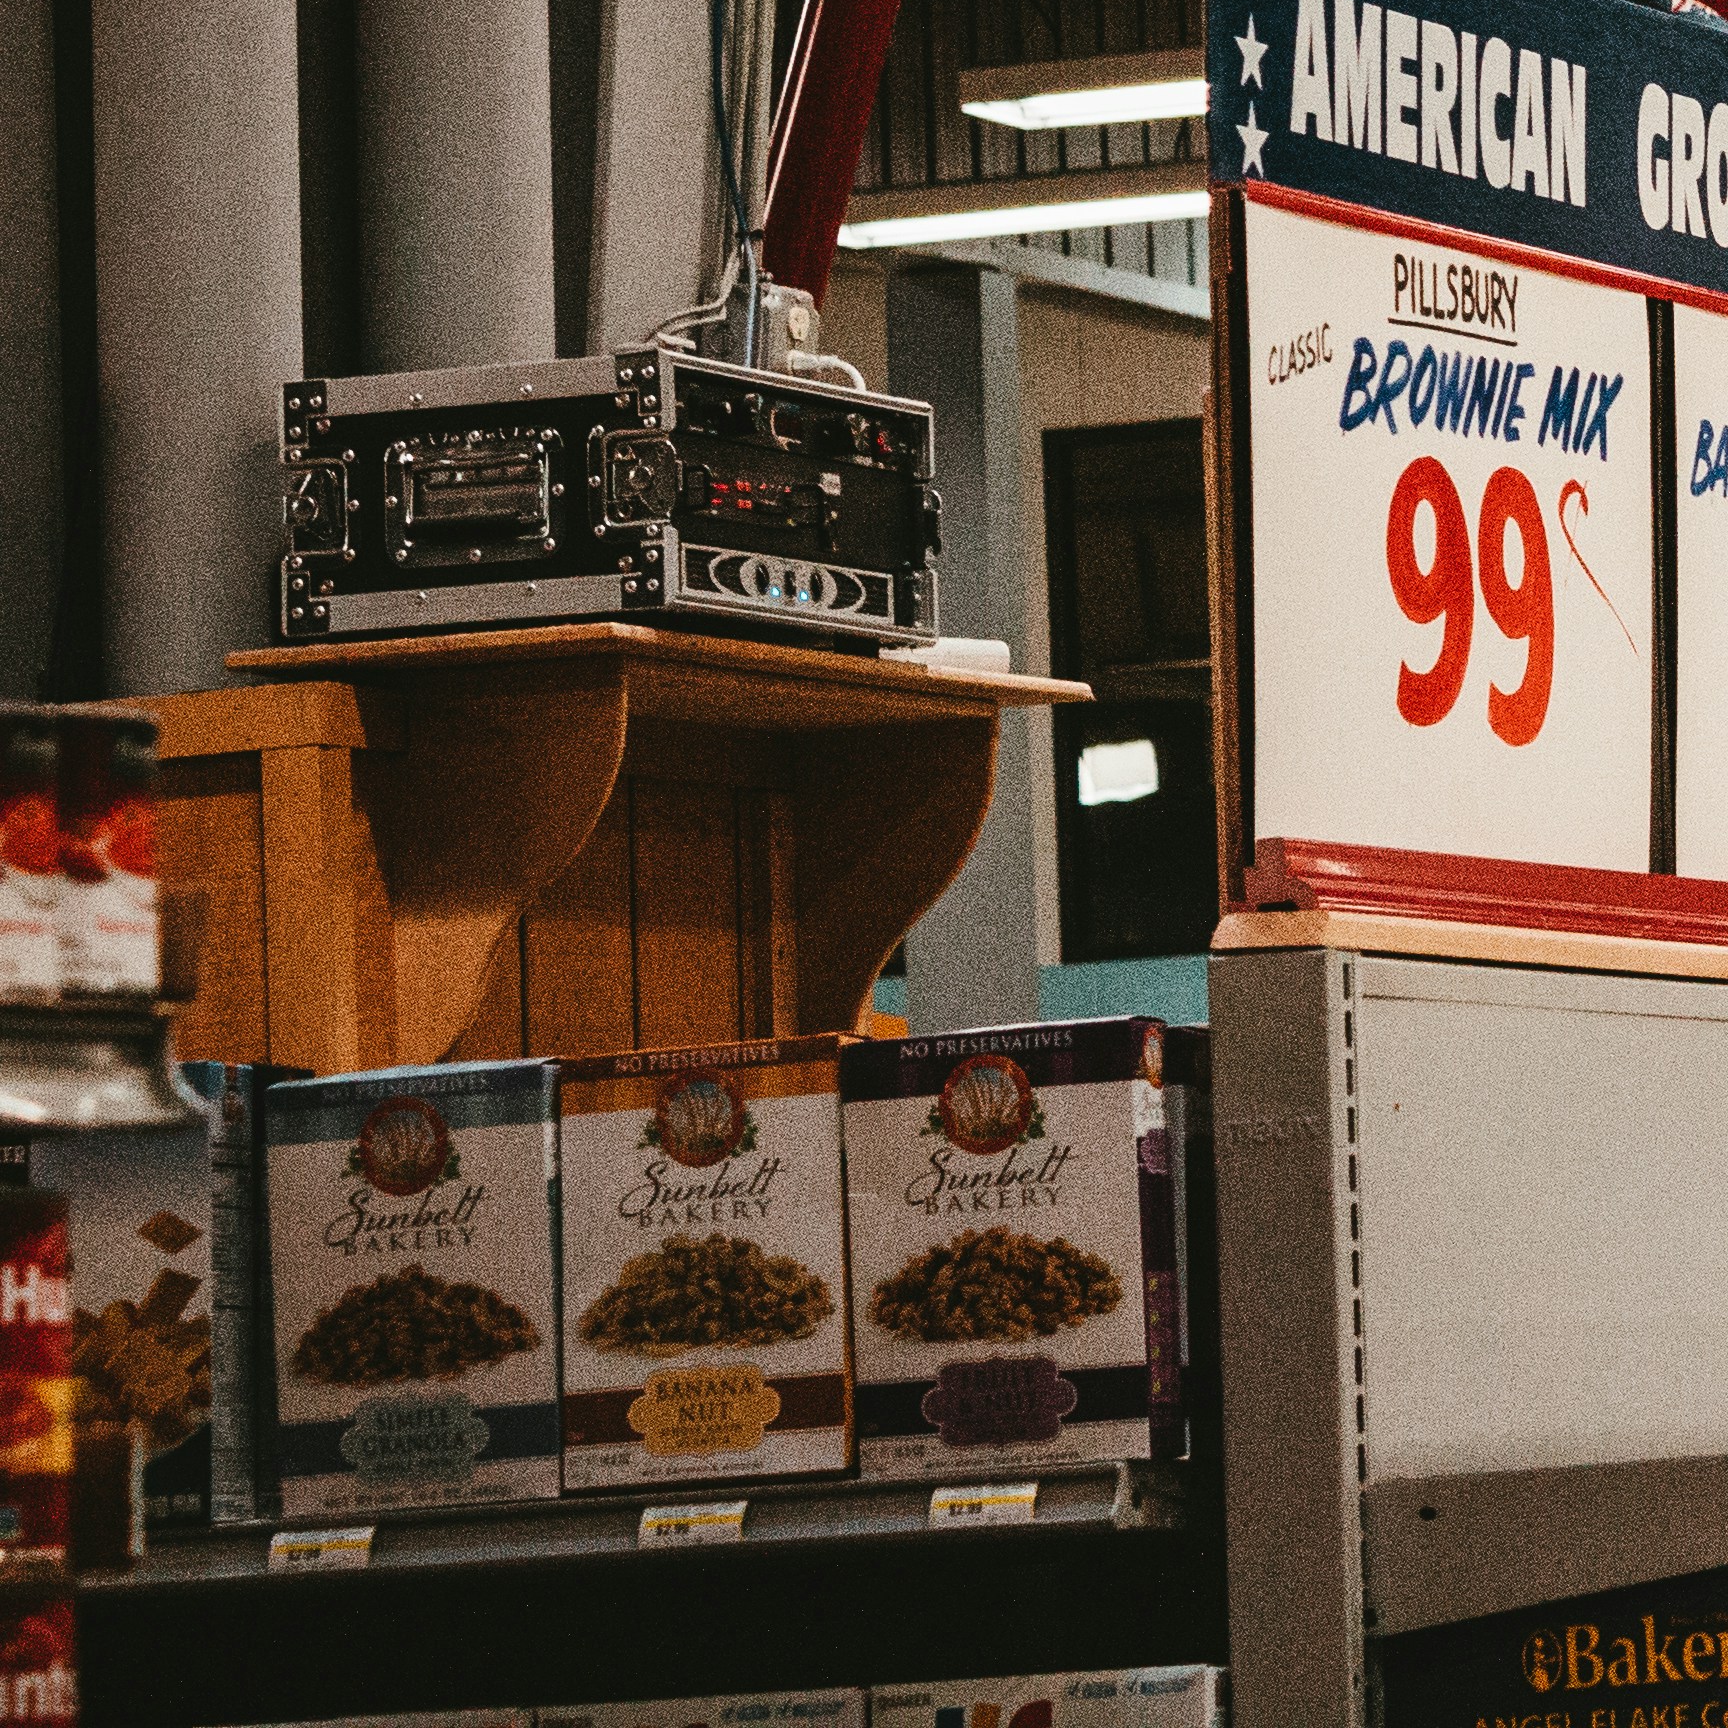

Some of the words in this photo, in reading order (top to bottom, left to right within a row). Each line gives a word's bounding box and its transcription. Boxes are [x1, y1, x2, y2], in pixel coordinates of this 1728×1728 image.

[1393, 253, 1519, 334] PILLSBURY
[1268, 321, 1334, 386] CLASSIC
[1339, 336, 1536, 442] BROWNIE
[1537, 365, 1626, 463] MIX
[614, 1055, 643, 1073] NO
[648, 1043, 781, 1069] PRESERVATIVES
[899, 1040, 931, 1060] NO
[934, 1029, 1075, 1057] PRESERVATIVES
[617, 1157, 785, 1219] Sunbelt
[905, 1144, 1080, 1208] Sunbelt
[323, 1184, 489, 1246] Sunbelt
[638, 1196, 774, 1229] BAKERY
[925, 1184, 1064, 1217] BAKERY
[343, 1225, 476, 1255] BAKERY
[655, 1377, 754, 1402] BANANA
[677, 1401, 735, 1423] NUT
